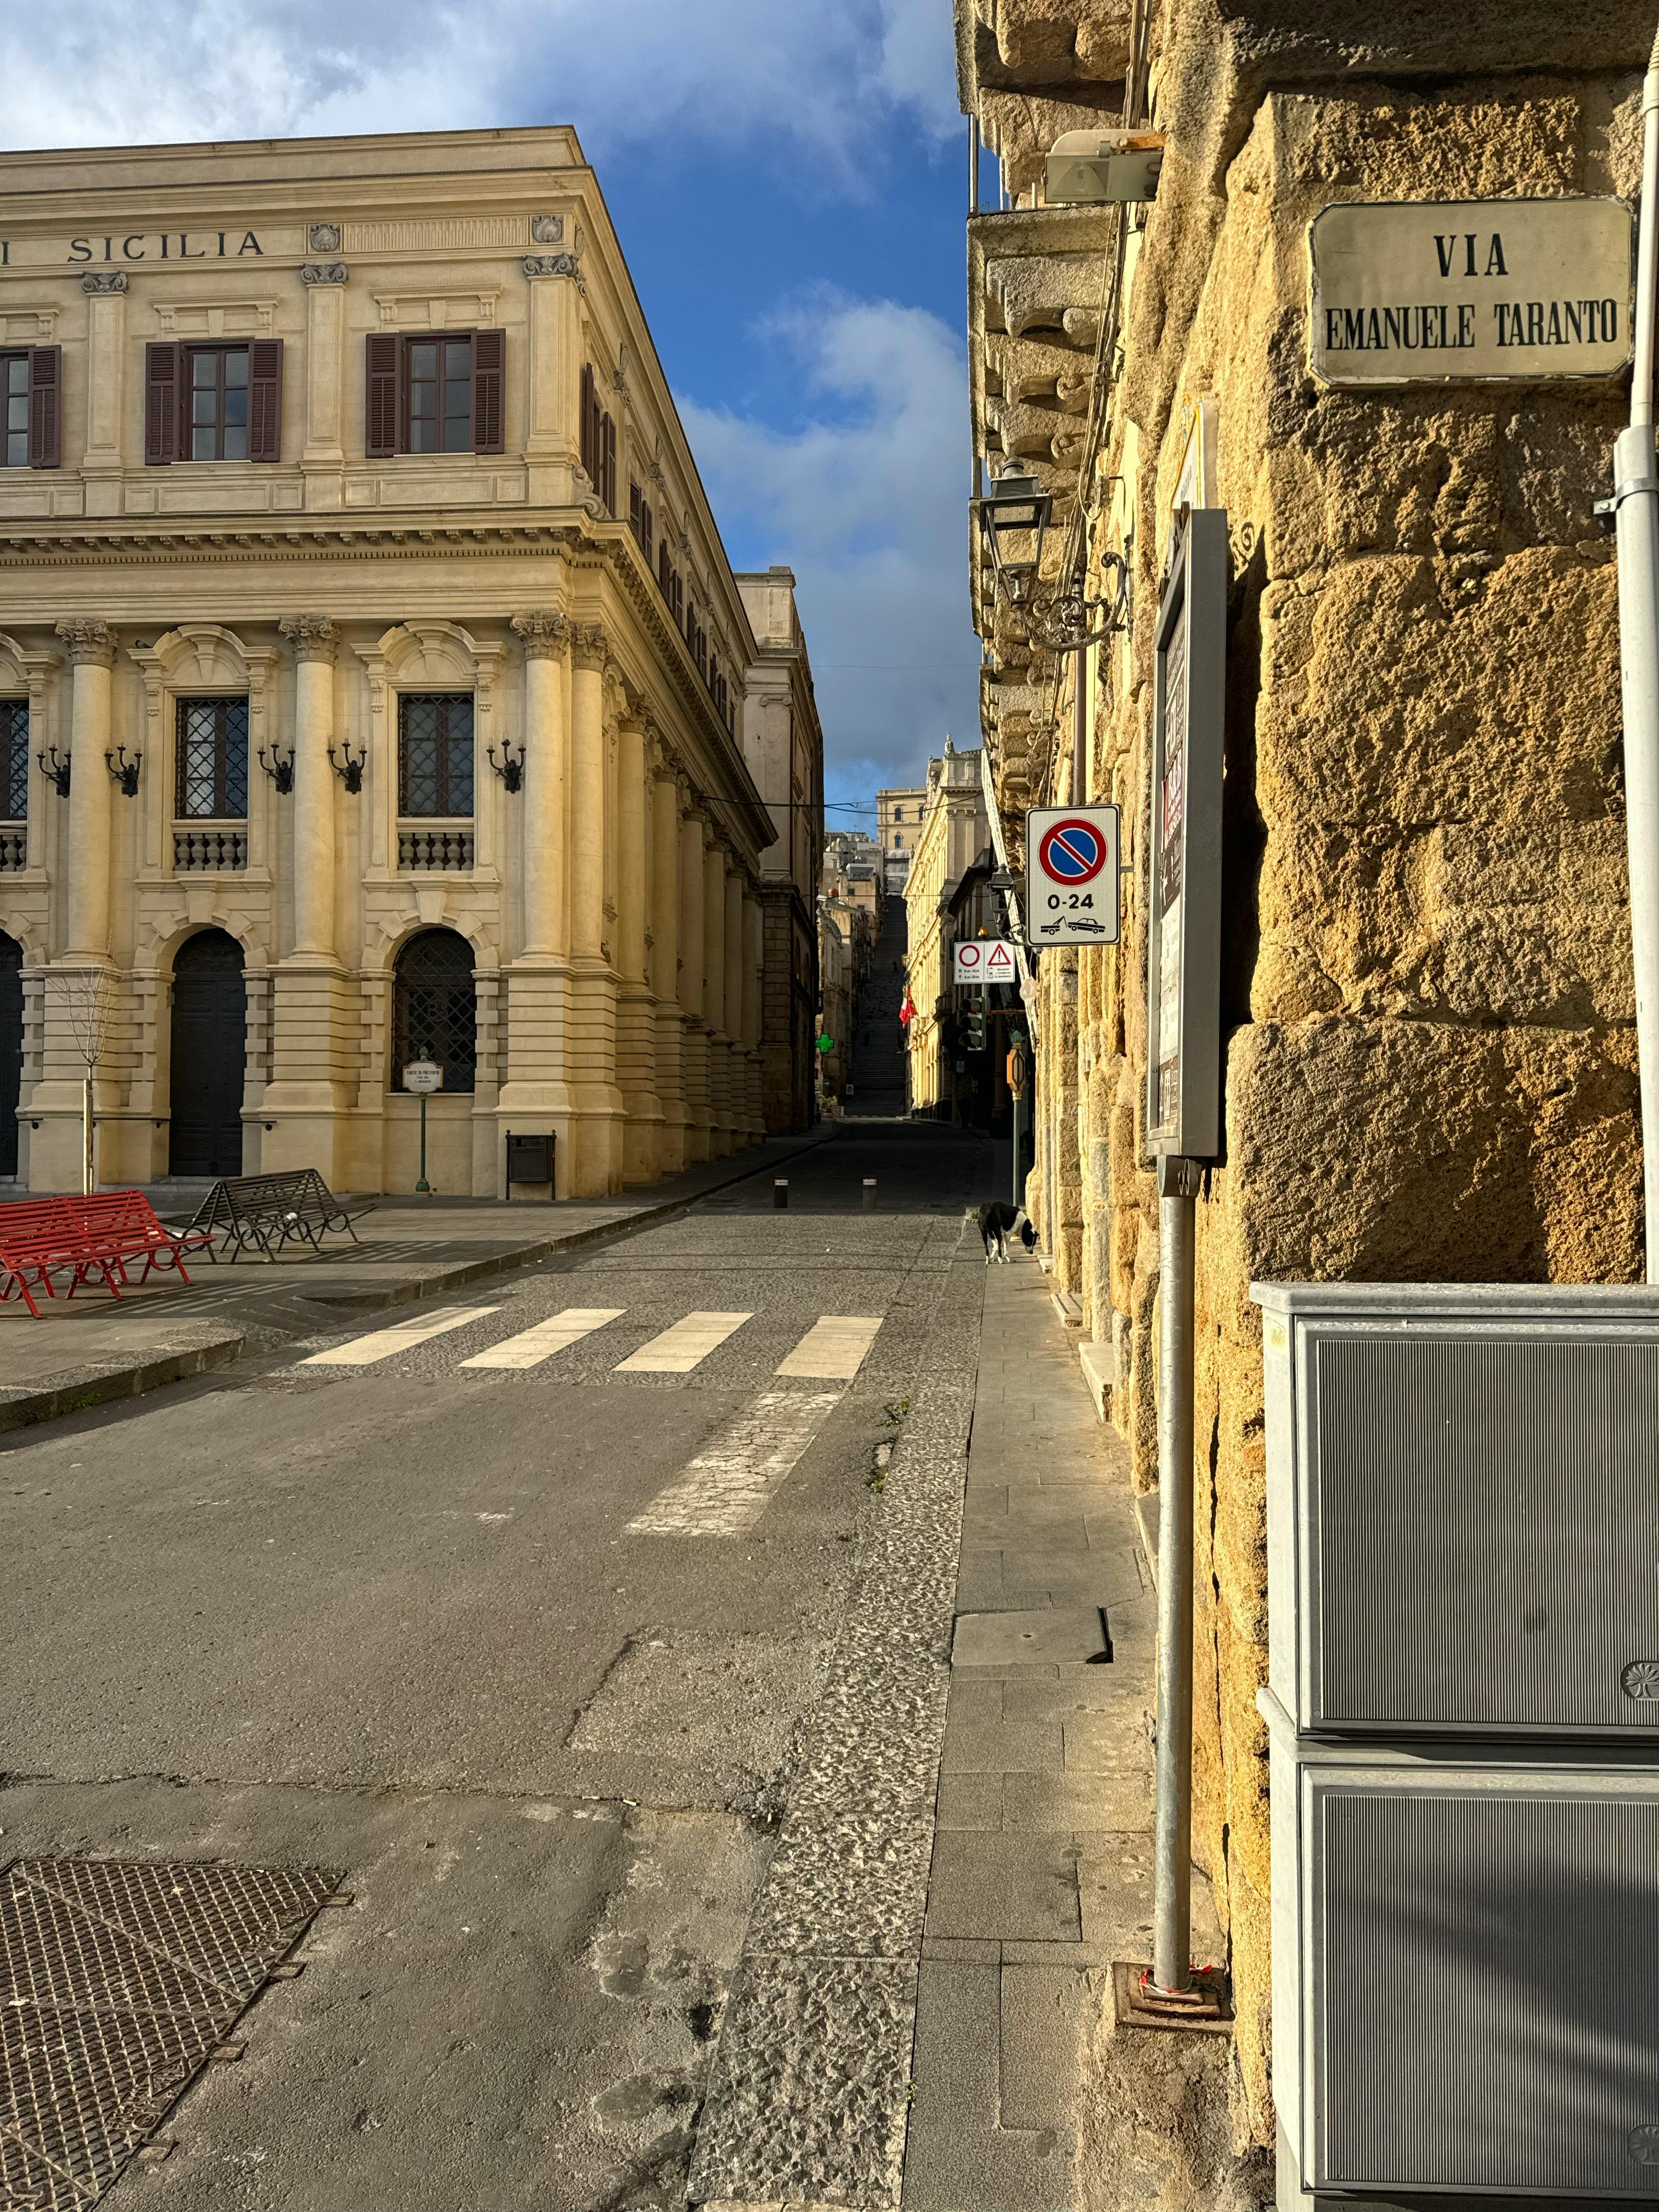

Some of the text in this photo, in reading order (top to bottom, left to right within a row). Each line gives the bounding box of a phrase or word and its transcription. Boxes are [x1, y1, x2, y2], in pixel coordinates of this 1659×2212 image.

[67, 231, 264, 263] SICILIA
[1434, 233, 1509, 277] VIA
[1325, 298, 1617, 350] EMANUELE TARANTO
[1047, 893, 1094, 910] 0-24
